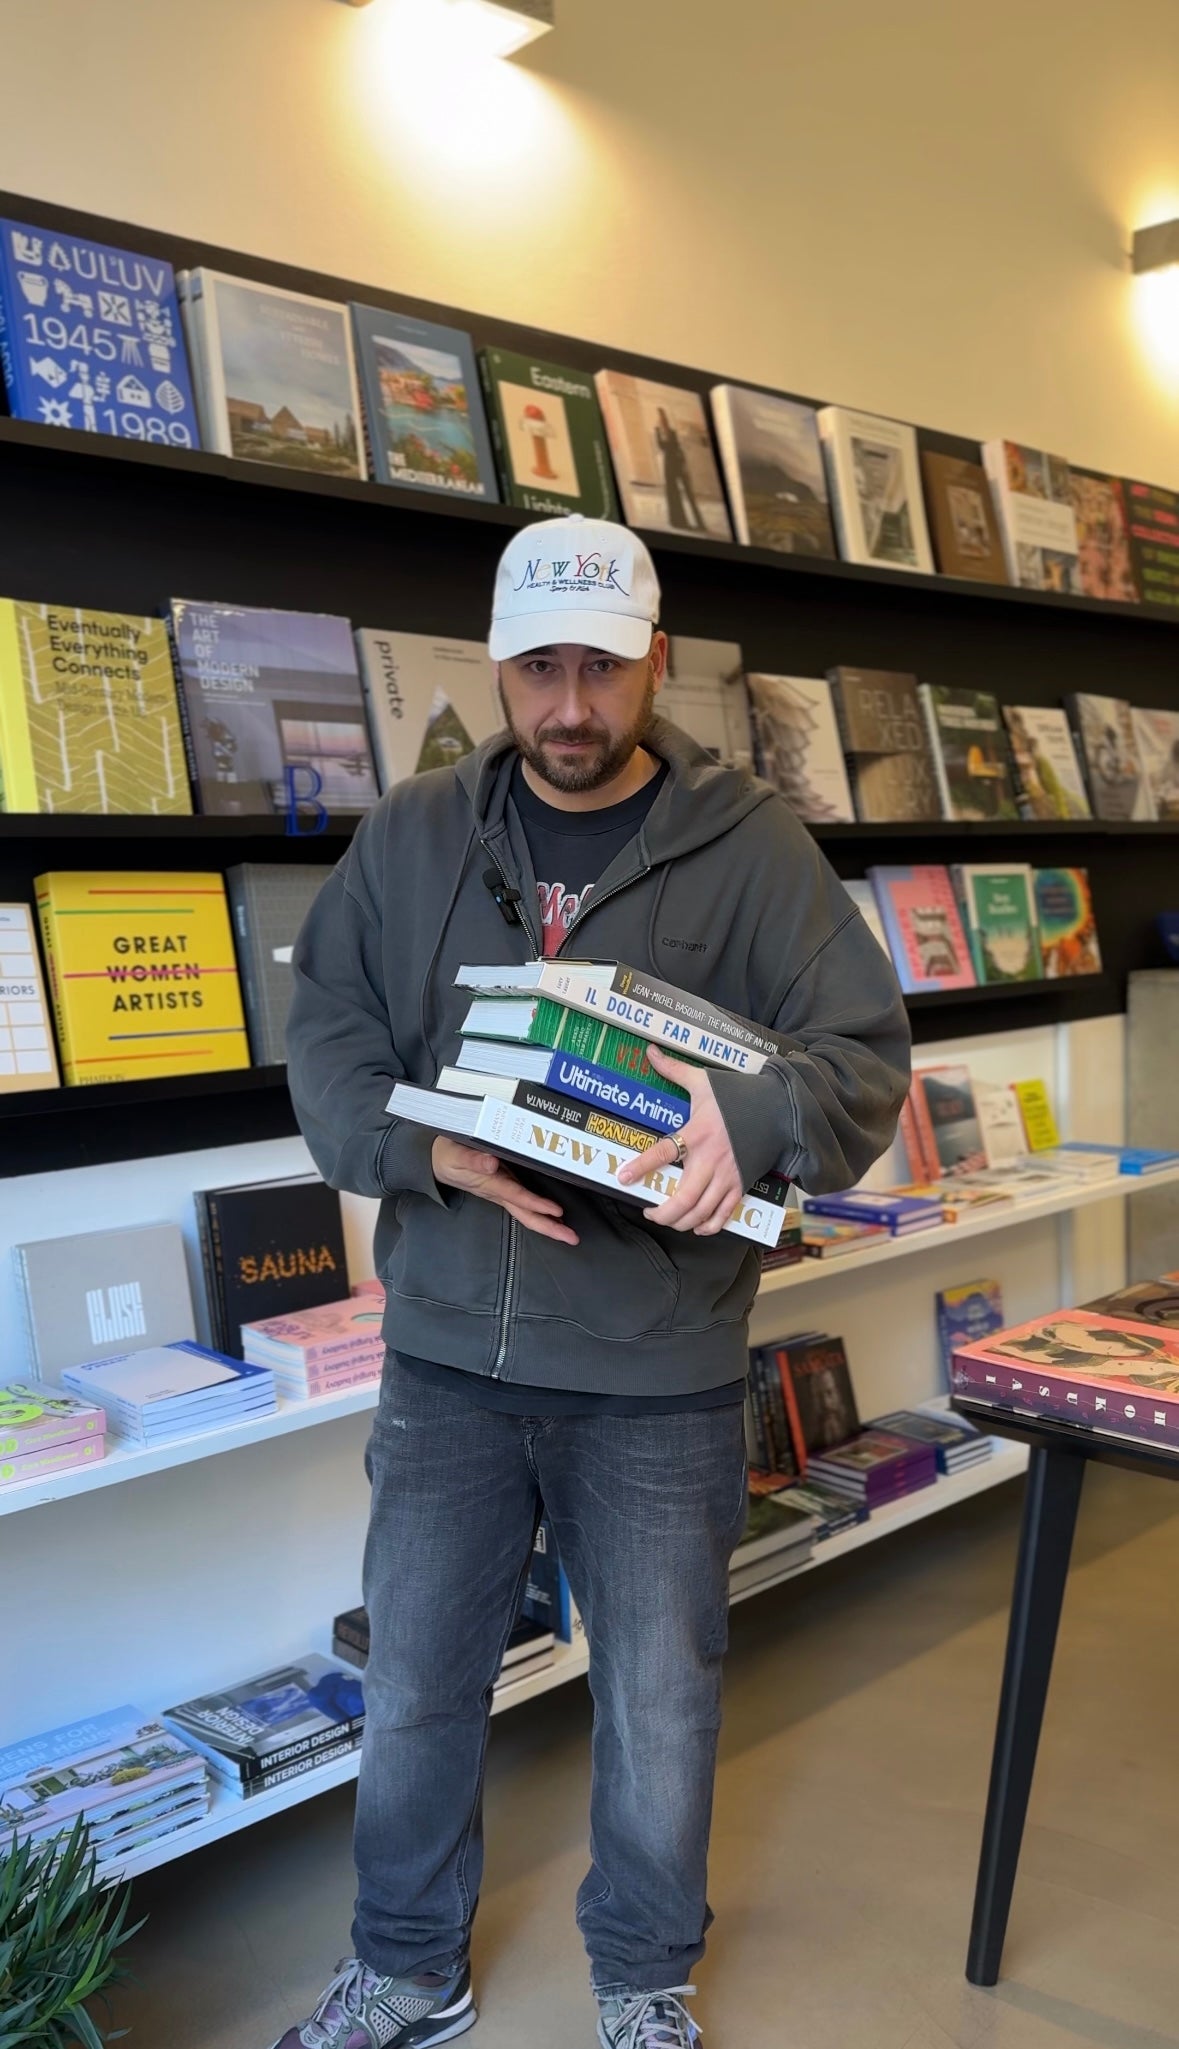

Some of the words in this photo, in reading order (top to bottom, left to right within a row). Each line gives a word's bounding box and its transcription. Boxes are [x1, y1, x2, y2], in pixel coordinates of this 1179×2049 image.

[22, 313, 117, 362] 1945
[530, 365, 592, 399] Eastern
[103, 408, 192, 449] 1989
[390, 466, 486, 495] MEDITERRANEAN
[527, 581, 551, 589] HEALTH
[560, 579, 597, 587] WELLNESS
[598, 582, 615, 590] CLUB
[47, 614, 141, 644] Eventually
[189, 612, 219, 629] THE
[50, 635, 148, 665] Everything
[191, 629, 220, 645] ART
[194, 643, 214, 659] OF
[52, 656, 141, 681] Connects
[197, 659, 260, 679] MODERN
[373, 639, 406, 721] private
[200, 676, 255, 693] DESIGN
[284, 764, 329, 838] B
[113, 935, 188, 954] GREAT
[106, 963, 201, 983] WOMEN
[112, 990, 204, 1012] ARTISTS
[585, 986, 597, 1006] IL
[606, 996, 654, 1028] DOLCE
[662, 1019, 691, 1045] FAR
[698, 1034, 749, 1069] NIENTE
[632, 983, 674, 1008] JEAN-MICHEL
[674, 1001, 707, 1022] BASQUIAT:
[707, 1016, 721, 1028] THE
[720, 1021, 744, 1039] MAKING
[744, 1030, 753, 1042] OF
[753, 1034, 763, 1047] AN
[763, 1038, 779, 1054] ICON
[526, 1093, 561, 1116] FRANTA
[559, 1060, 630, 1107] Ultimate
[629, 1092, 684, 1129] Anime
[560, 1106, 582, 1123] JIŘÍ
[526, 1123, 602, 1165] NEW
[606, 1151, 681, 1198] YRK
[240, 1246, 336, 1284] SAUNA
[56, 1723, 99, 1742] FOR
[197, 1709, 255, 1747] INTERIOR
[215, 1706, 265, 1736] DESIGN
[260, 1739, 311, 1769] INTERIOR
[311, 1723, 350, 1748] DESIGN
[263, 1758, 313, 1788] INTERIOR
[314, 1741, 353, 1766] DESIGN
